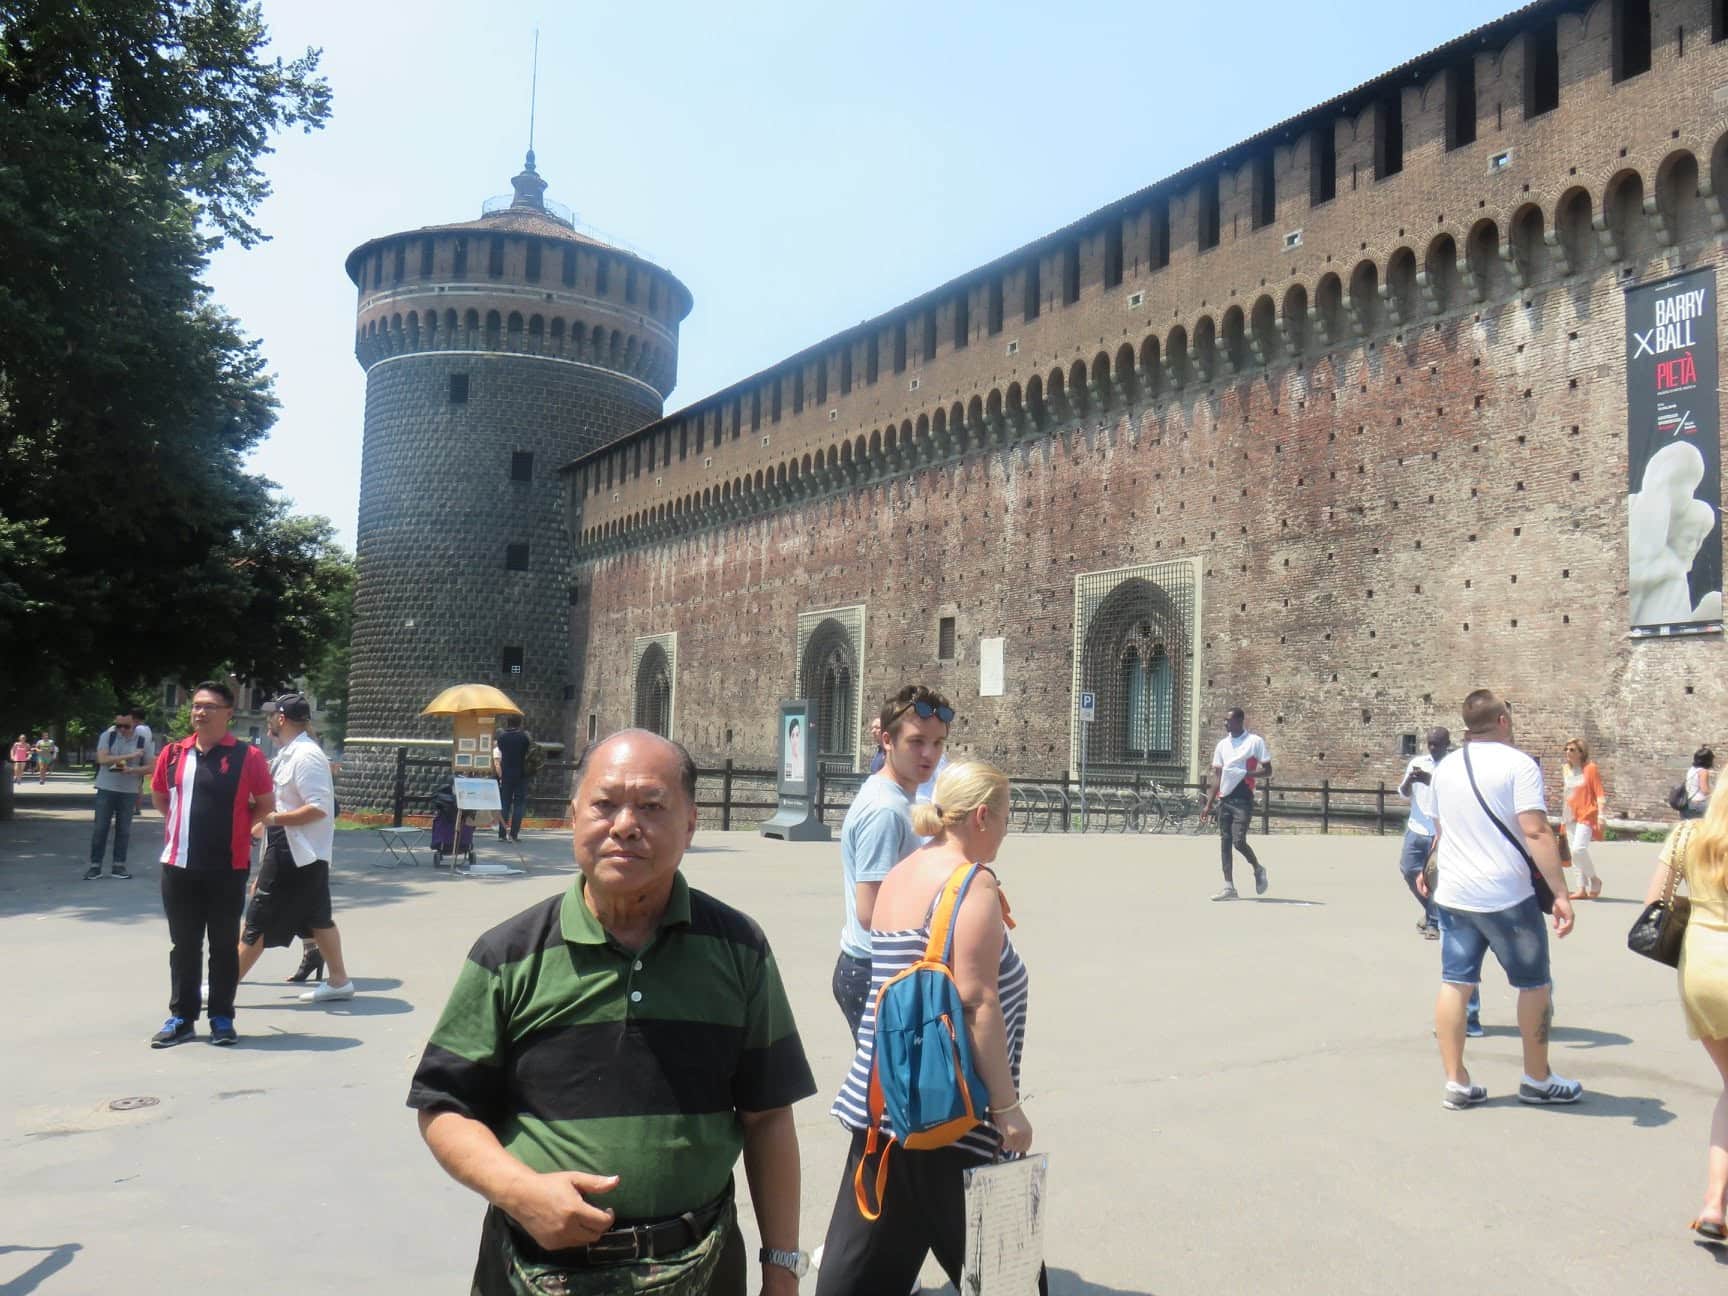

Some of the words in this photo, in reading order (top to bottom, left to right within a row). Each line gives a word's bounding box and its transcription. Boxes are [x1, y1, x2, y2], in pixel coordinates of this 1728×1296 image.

[1655, 288, 1705, 327] BARRY
[1655, 319, 1696, 354] BALL
[1655, 351, 1697, 389] PIETÀ
